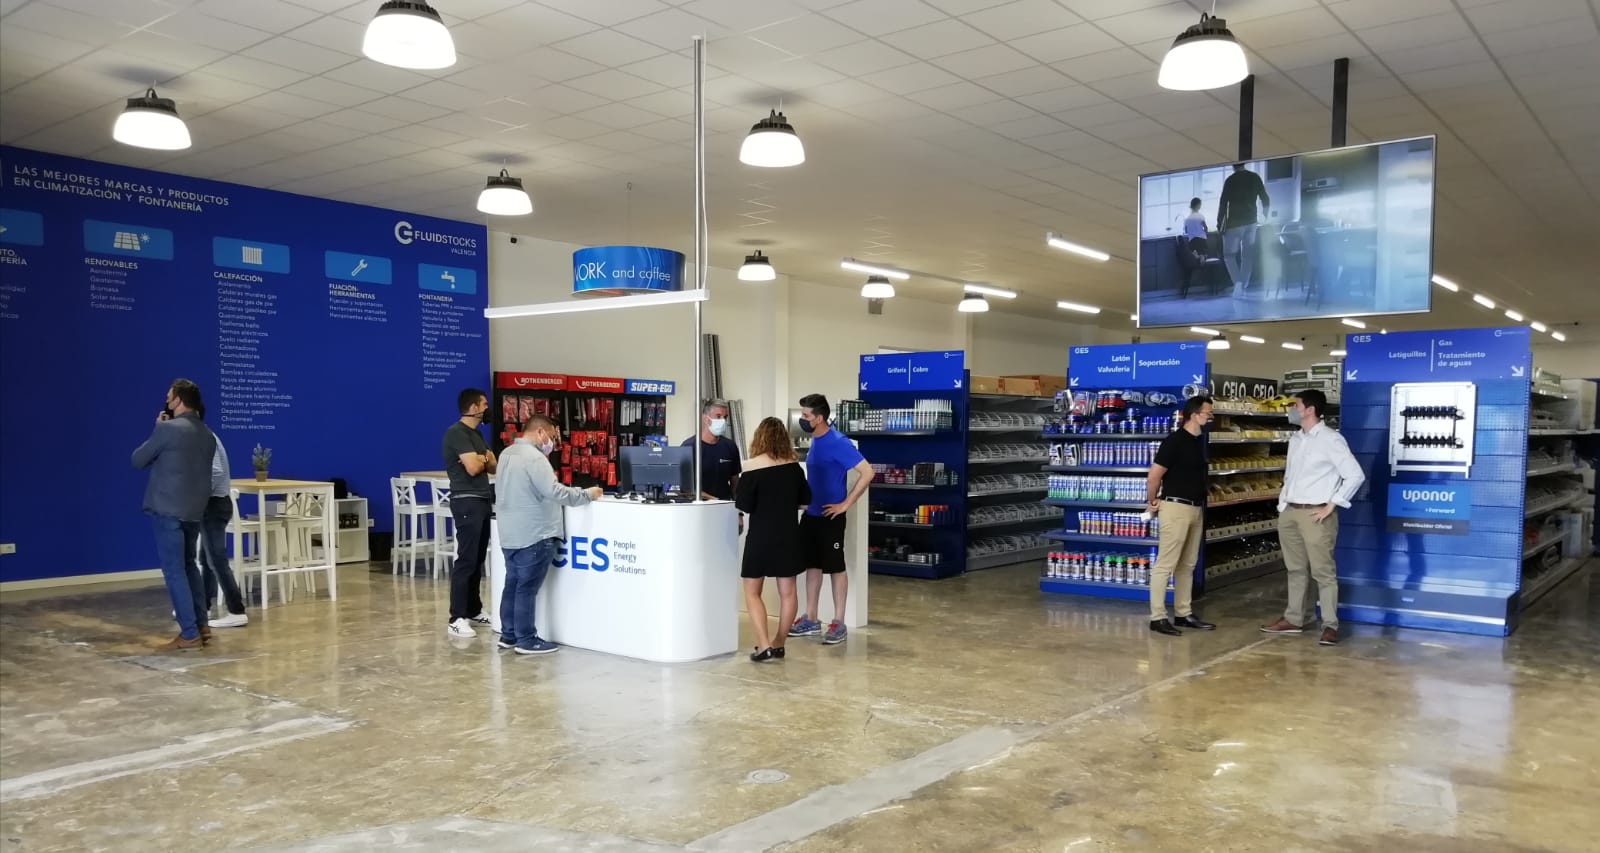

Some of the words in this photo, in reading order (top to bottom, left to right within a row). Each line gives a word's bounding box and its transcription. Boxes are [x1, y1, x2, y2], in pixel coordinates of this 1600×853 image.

[14, 165, 38, 177] LAS
[43, 169, 100, 186] MEJORES
[104, 179, 153, 194] MARCAS
[157, 187, 165, 196] Y
[168, 189, 229, 207] PRODUCTOS
[14, 176, 30, 187] EN
[34, 179, 121, 201] CLIMATIZACIÓN
[126, 193, 133, 203] Y
[138, 195, 203, 213] FONTANERÍA
[415, 230, 477, 249] FLUIDSTOCKS
[450, 248, 476, 256] VALENCIA
[84, 257, 139, 270] RENOVABLES
[214, 271, 263, 283] CALEFACCIÓN
[612, 265, 635, 279] and
[639, 267, 671, 282] coffee
[89, 275, 126, 286] Geotermia
[90, 284, 119, 293] Biomasa
[218, 288, 243, 297] Calderas
[91, 293, 109, 301] Solar
[218, 296, 243, 304] Calderas
[329, 289, 376, 301] HERRAMIENTAS
[218, 304, 243, 312] Calderas
[1111, 354, 1131, 362] Latón
[1388, 350, 1427, 359] Latiguillos
[1438, 351, 1486, 359] Tratamiento
[1138, 358, 1180, 368] Soportación
[1449, 360, 1472, 368] aguas
[520, 377, 563, 385] ROTHENBERGER
[581, 380, 621, 389] ROTHENBERGER
[630, 382, 673, 393] SUPER-EGO
[1402, 489, 1456, 503] uponor
[613, 540, 637, 551] People
[613, 551, 637, 563] Energy
[613, 564, 647, 576] Solutions
